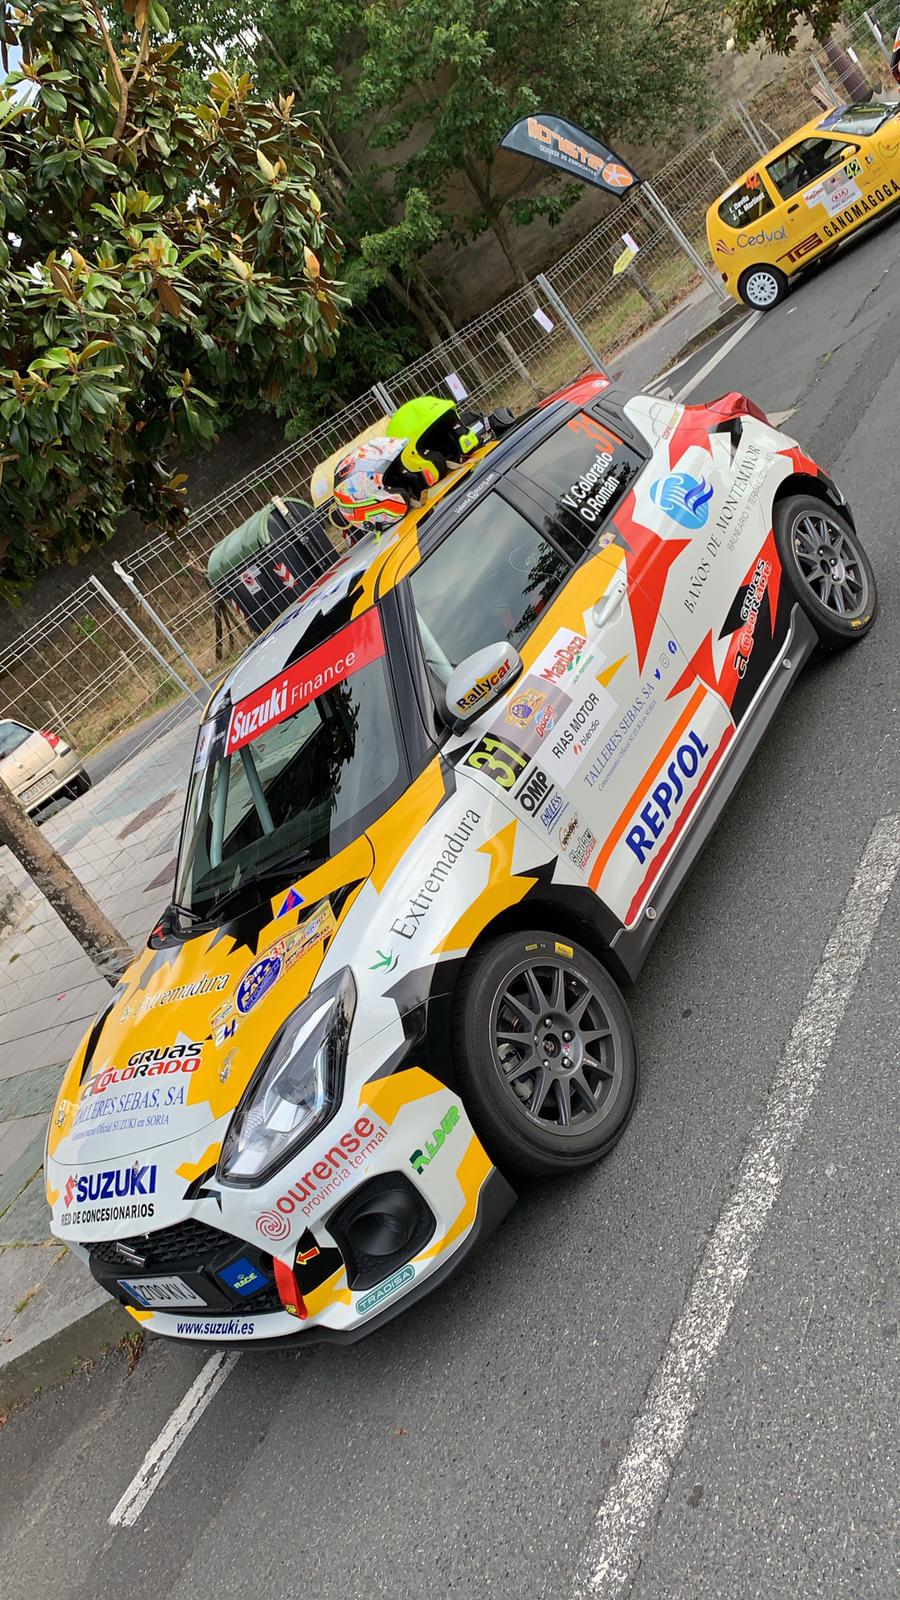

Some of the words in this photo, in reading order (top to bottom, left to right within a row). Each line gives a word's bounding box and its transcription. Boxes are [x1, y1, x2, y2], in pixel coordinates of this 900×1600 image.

[844, 159, 861, 180] 42
[823, 178, 900, 238] GANOMAGOGA
[736, 226, 788, 248] Cedval
[567, 411, 624, 454] 31
[562, 451, 613, 509] V.Colorado
[580, 475, 620, 522] O.Román
[683, 557, 712, 614] BAÑOS
[706, 532, 723, 557] DE
[715, 444, 761, 536] MONTEMAYOR
[739, 558, 767, 620] GRUAS
[540, 635, 587, 685] MaxiDeza
[231, 679, 289, 744] Suzuki
[290, 651, 357, 706] Finance
[456, 658, 511, 710] Rallycar
[552, 729, 574, 760] RIAS
[570, 692, 600, 733] MOTOR
[581, 719, 600, 746] blendio
[583, 731, 623, 788] TALLERES
[619, 696, 647, 735] SEBAS,
[641, 682, 656, 701] SA
[468, 737, 528, 789] 31
[520, 770, 549, 813] OMP
[540, 791, 563, 827] ENDLESS
[625, 730, 709, 865] REPSOL
[389, 808, 481, 941] Extremadura
[127, 1042, 204, 1067] GRUAS
[116, 1088, 160, 1113] SEBAS,
[164, 1085, 184, 1107] SA
[112, 1117, 138, 1133] SUZUKI
[145, 1113, 170, 1127] SORIA
[76, 1164, 158, 1203] SUZUKI
[276, 1116, 375, 1215] ourense
[301, 1168, 352, 1218] provincia
[349, 1125, 389, 1170] termal
[61, 1212, 72, 1227] RED
[72, 1211, 81, 1225] DE
[81, 1203, 155, 1224] CONCESIONARIOS
[233, 1271, 258, 1290] RACE
[360, 1270, 411, 1310] TRADISA
[176, 1319, 255, 1336] www.suzuki.es
